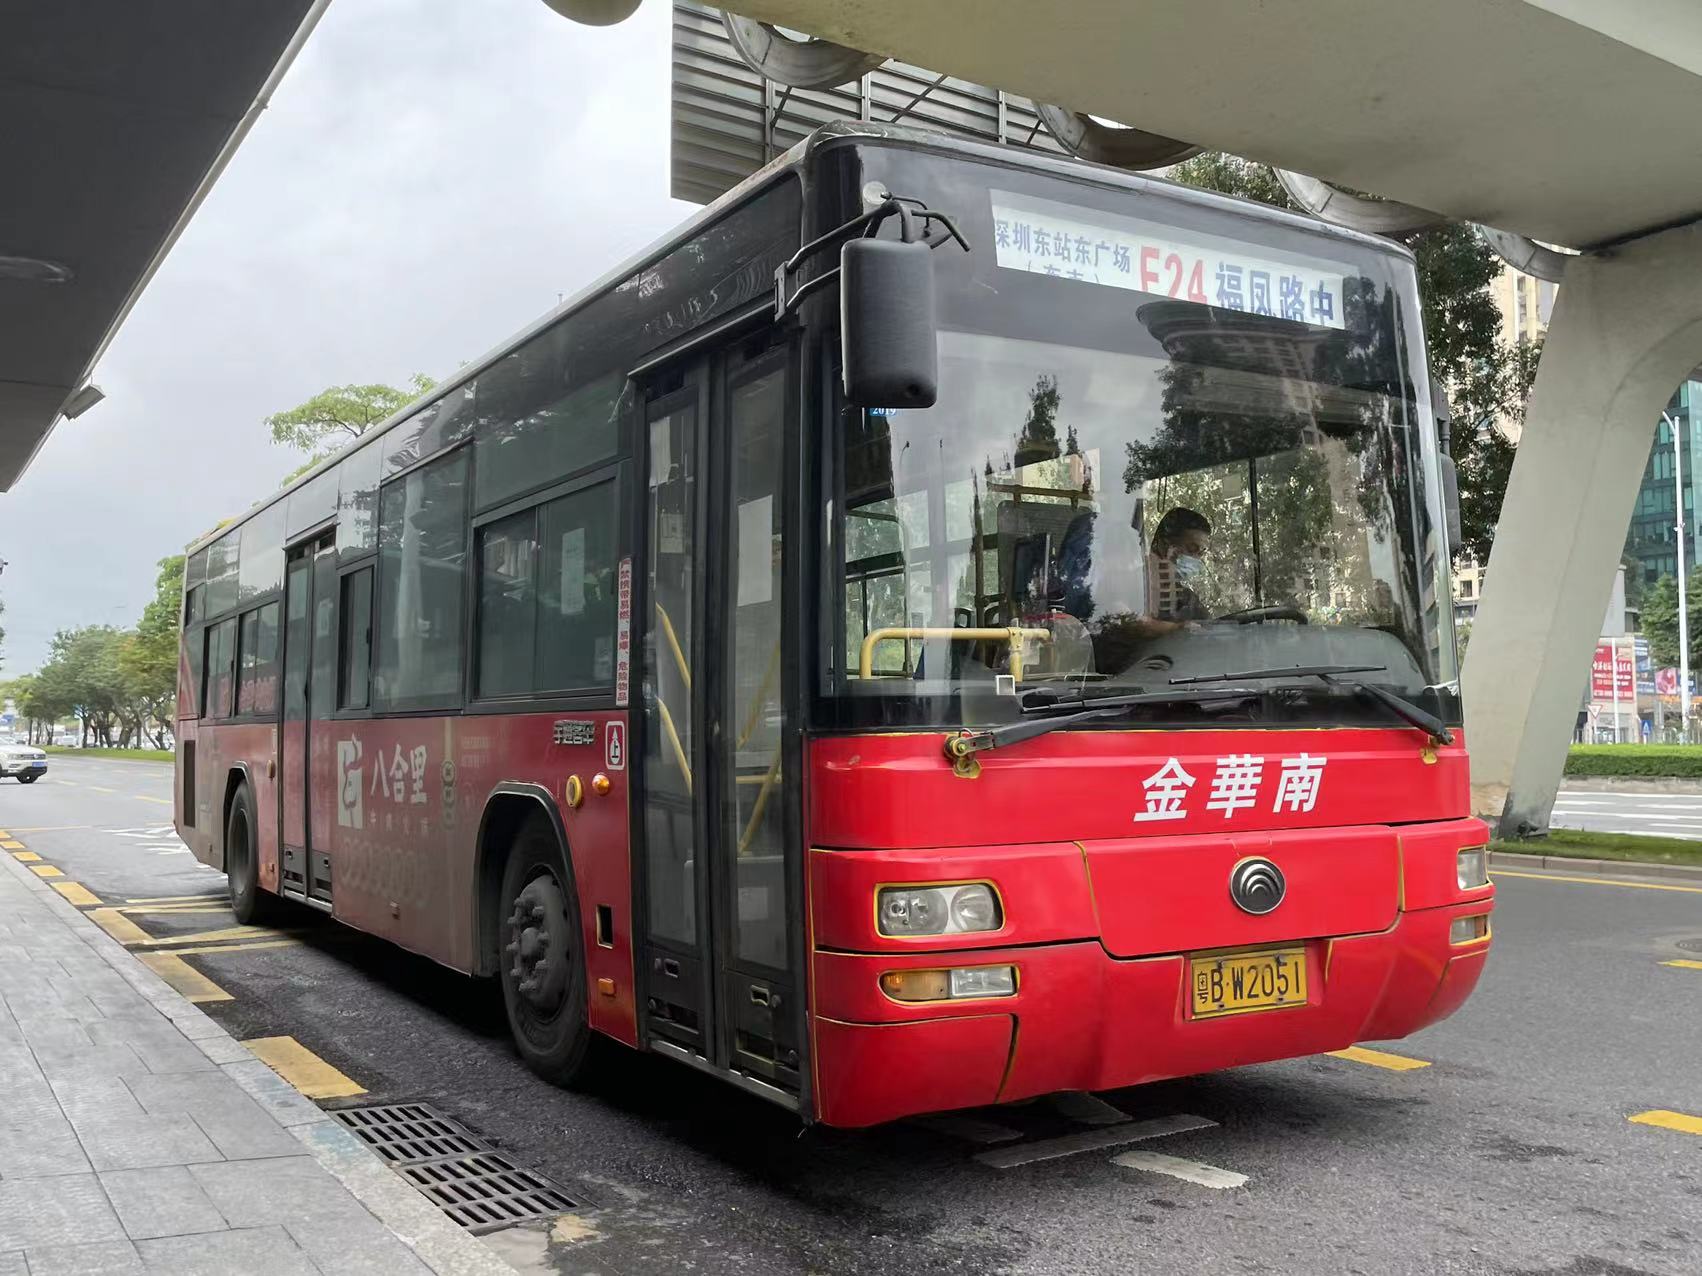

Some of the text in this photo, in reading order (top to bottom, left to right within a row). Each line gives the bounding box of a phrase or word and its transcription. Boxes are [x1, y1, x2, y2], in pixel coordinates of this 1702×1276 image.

[995, 219, 1131, 274] 深圳东站东广场
[370, 743, 428, 804] 八合里
[1133, 752, 1327, 822] 金華南
